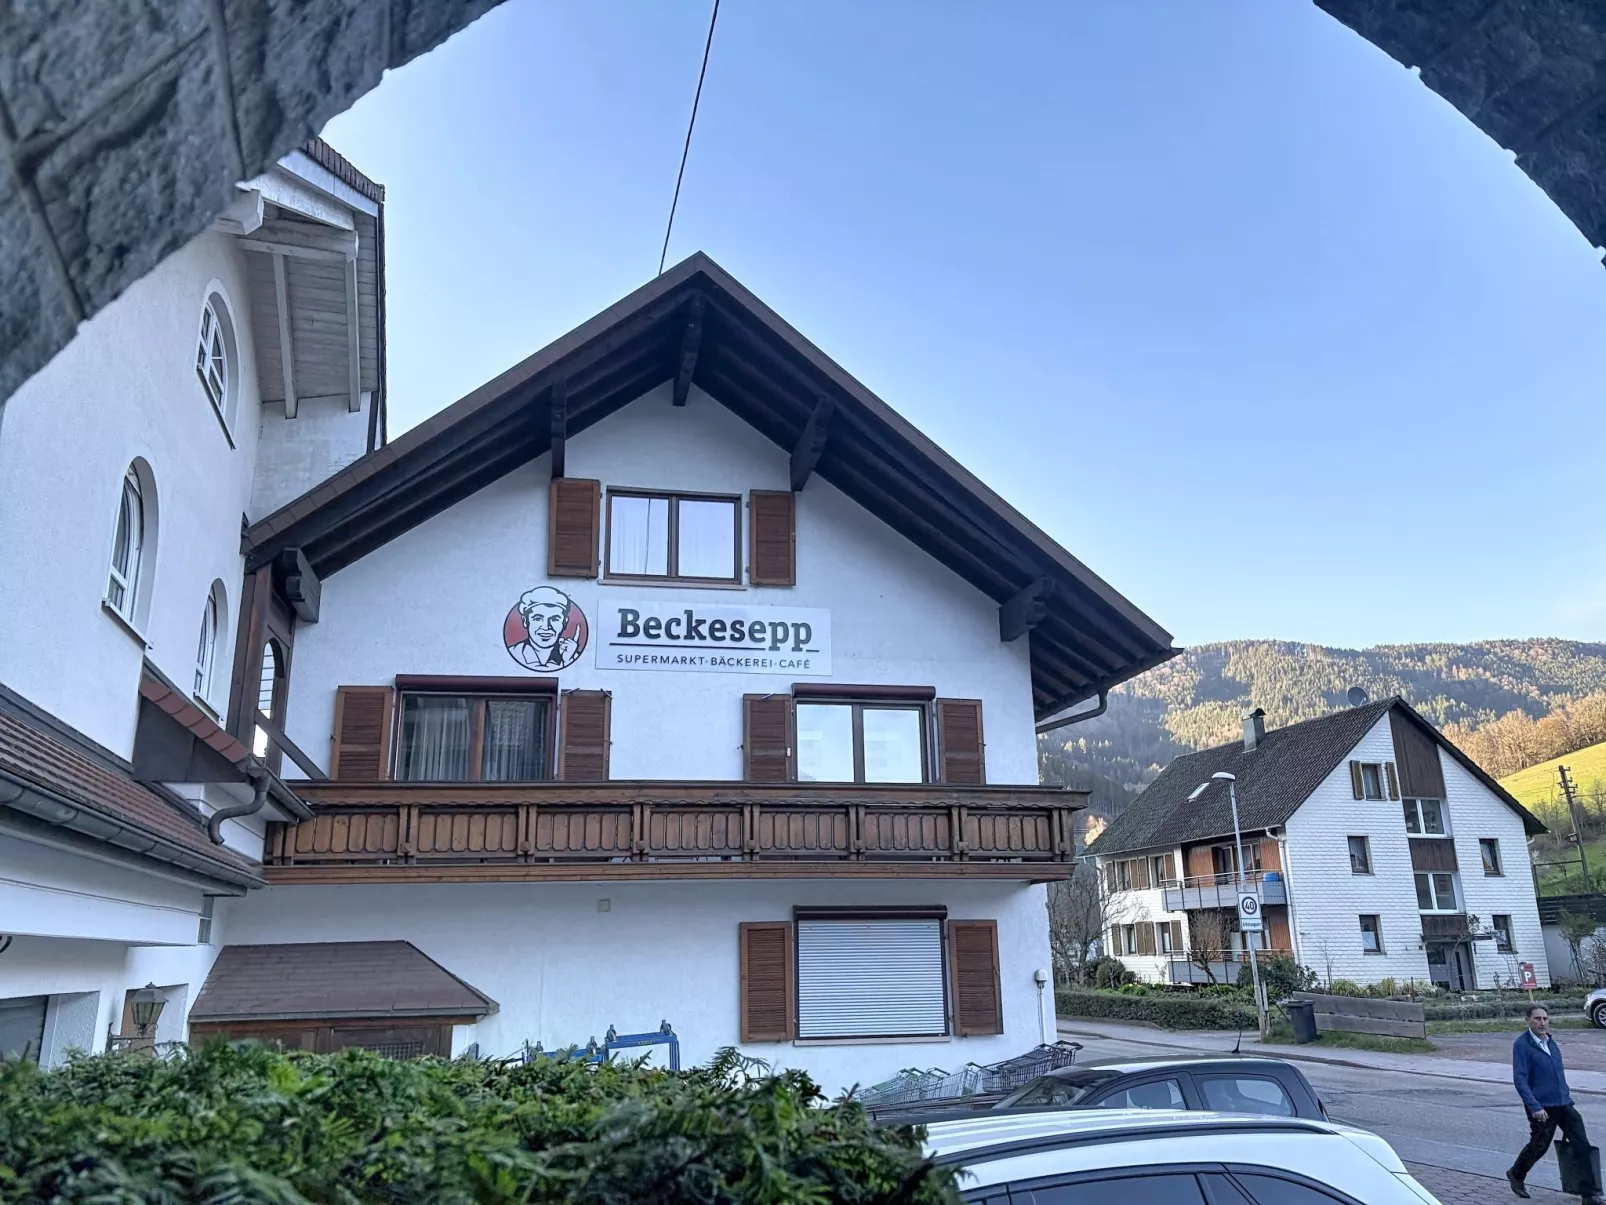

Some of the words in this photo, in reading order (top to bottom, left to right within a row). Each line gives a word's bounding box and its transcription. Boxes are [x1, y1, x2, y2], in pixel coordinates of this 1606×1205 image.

[617, 608, 812, 651] Beckesepp
[779, 659, 811, 670] CAFÉ
[1245, 901, 1254, 910] 40
[1524, 971, 1532, 982] P
